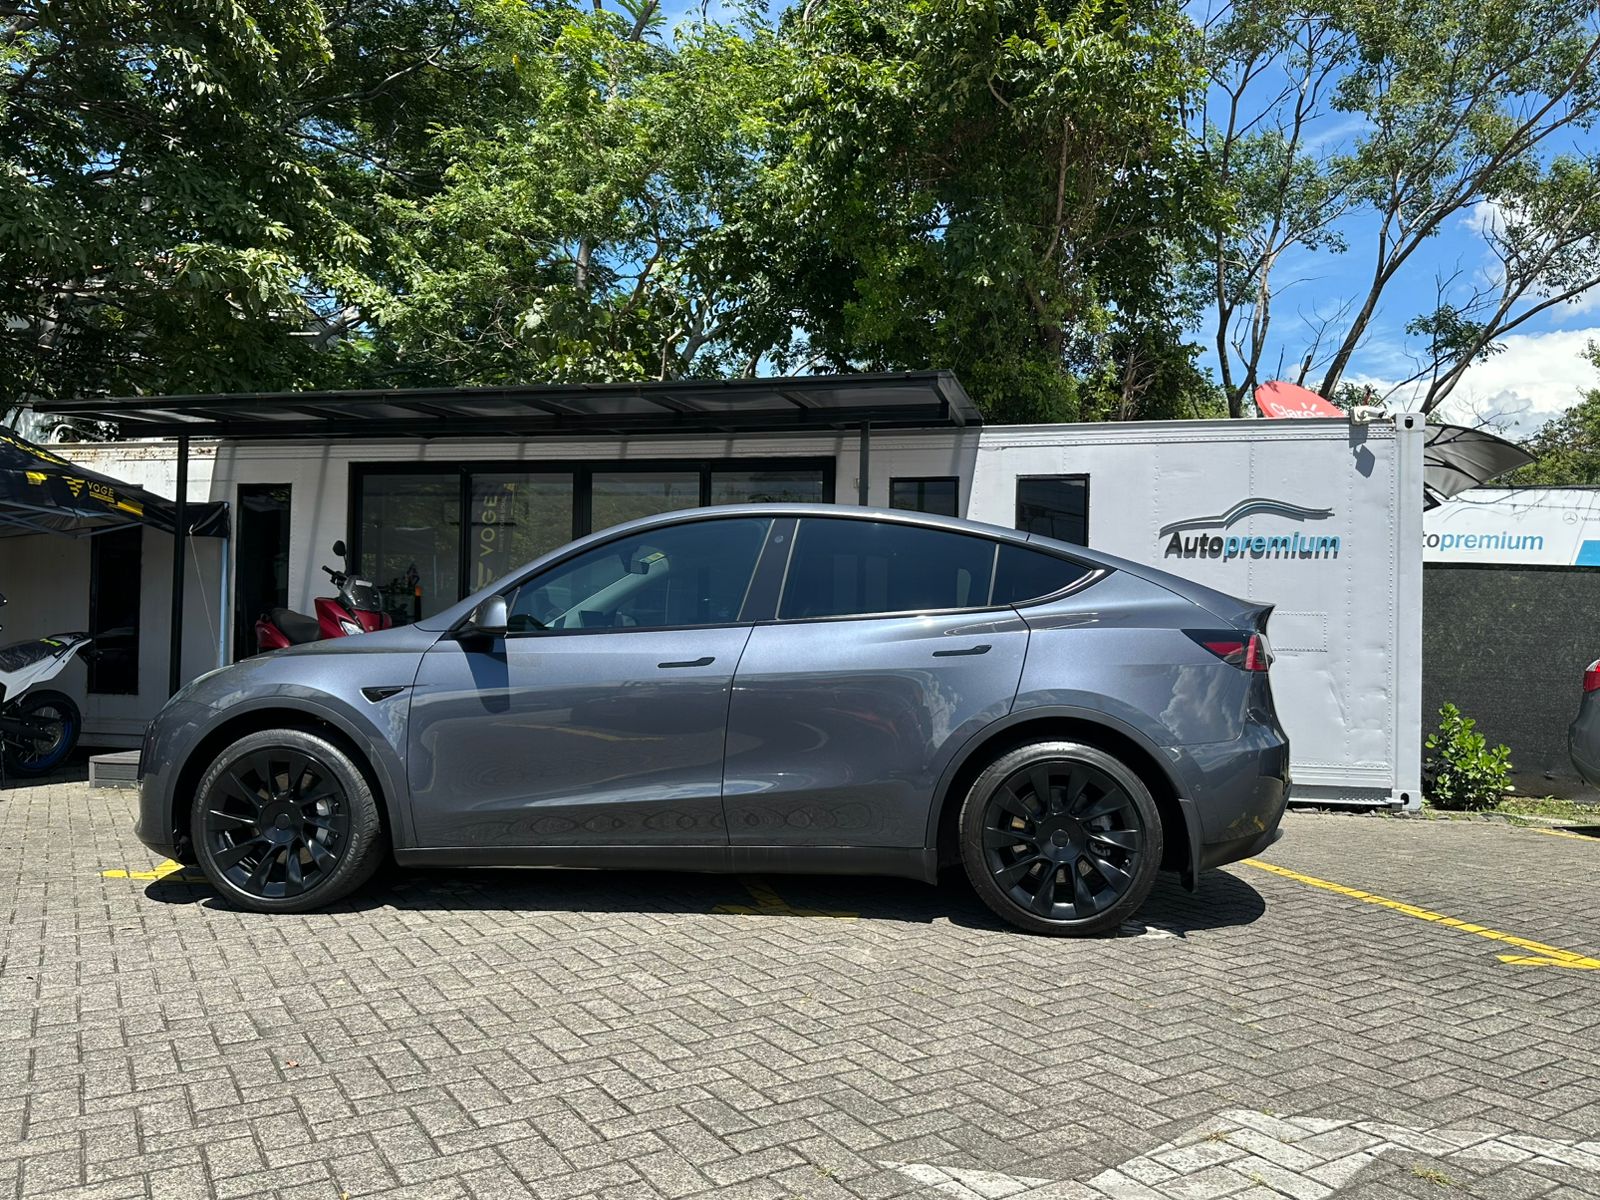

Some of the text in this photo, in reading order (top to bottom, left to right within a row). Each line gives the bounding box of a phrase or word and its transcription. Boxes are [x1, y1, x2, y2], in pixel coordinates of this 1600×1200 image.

[1270, 402, 1317, 417] Claro
[87, 481, 115, 497] VOGE
[480, 496, 498, 557] VOGE
[1165, 531, 1341, 561] Autopremium
